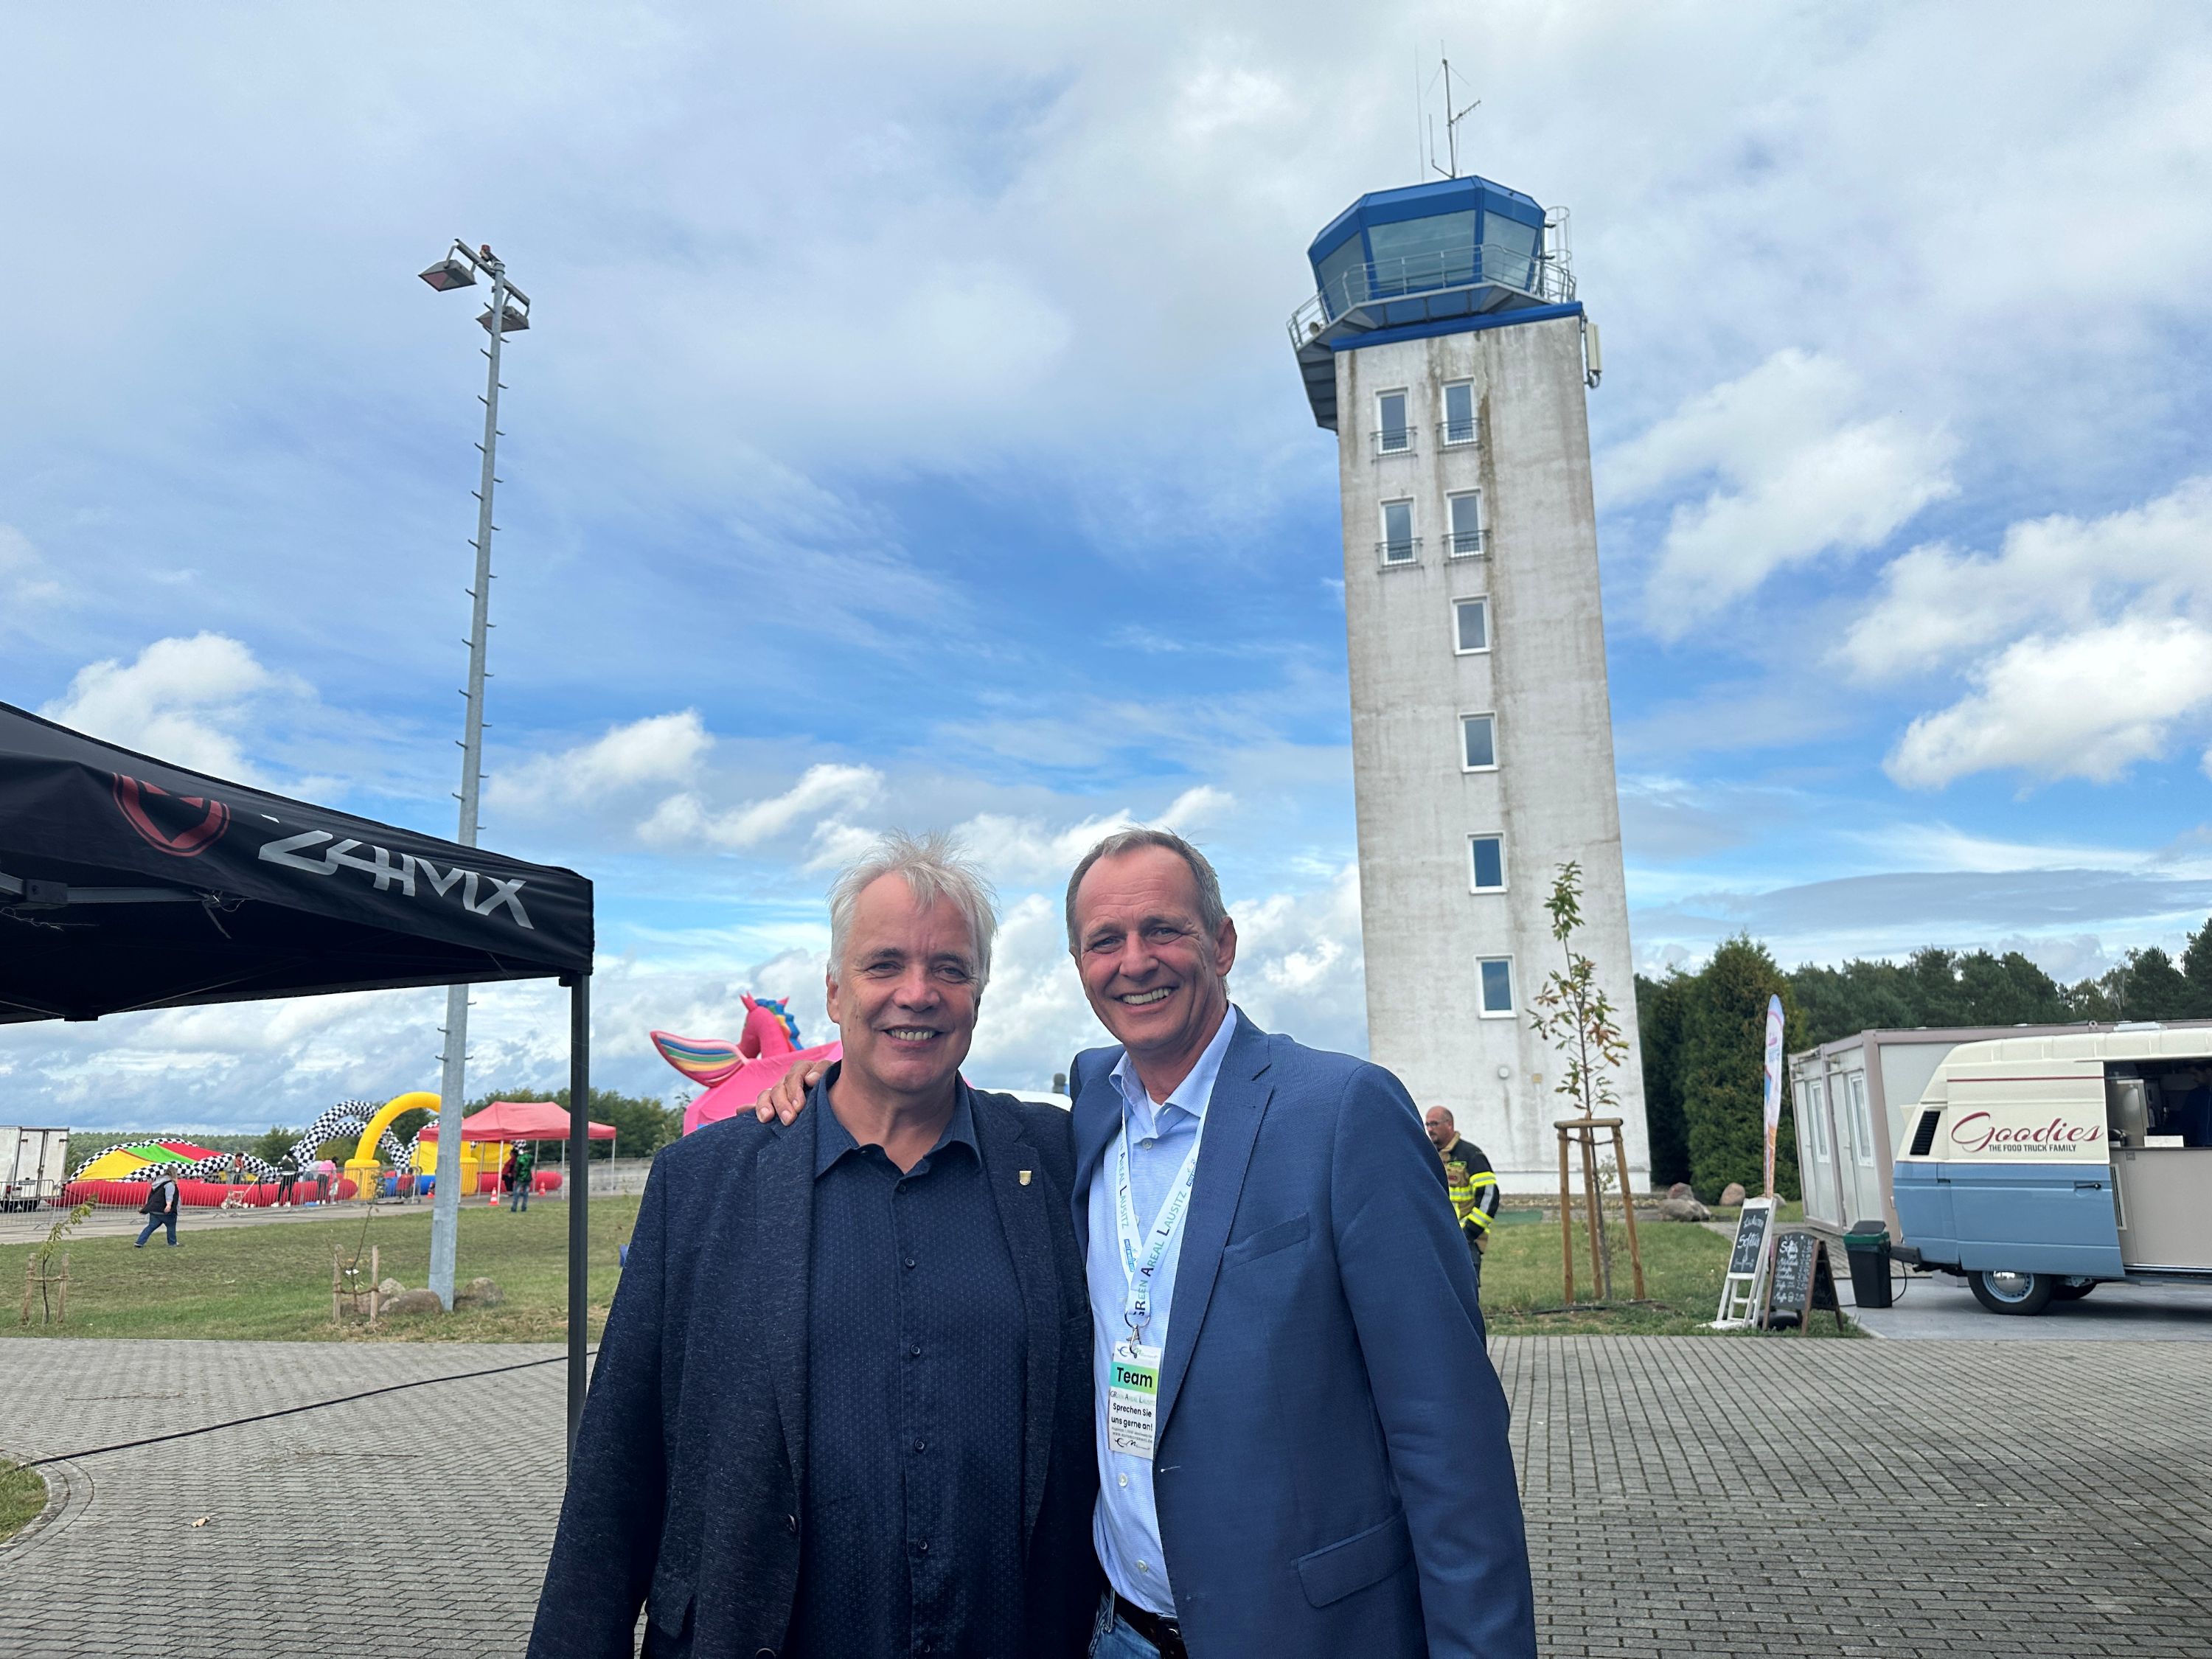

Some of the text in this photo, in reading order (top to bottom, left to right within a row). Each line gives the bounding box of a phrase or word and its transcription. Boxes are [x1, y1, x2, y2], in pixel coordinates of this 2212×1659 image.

[1951, 1111, 2104, 1152] Goodies
[1141, 1241, 1165, 1277] AREAL
[1157, 1191, 1187, 1237] LAUSITZ
[1116, 1366, 1152, 1388] Team
[1113, 1402, 1152, 1417] Sprechen Sie
[1111, 1416, 1153, 1431] uns gerne an!
